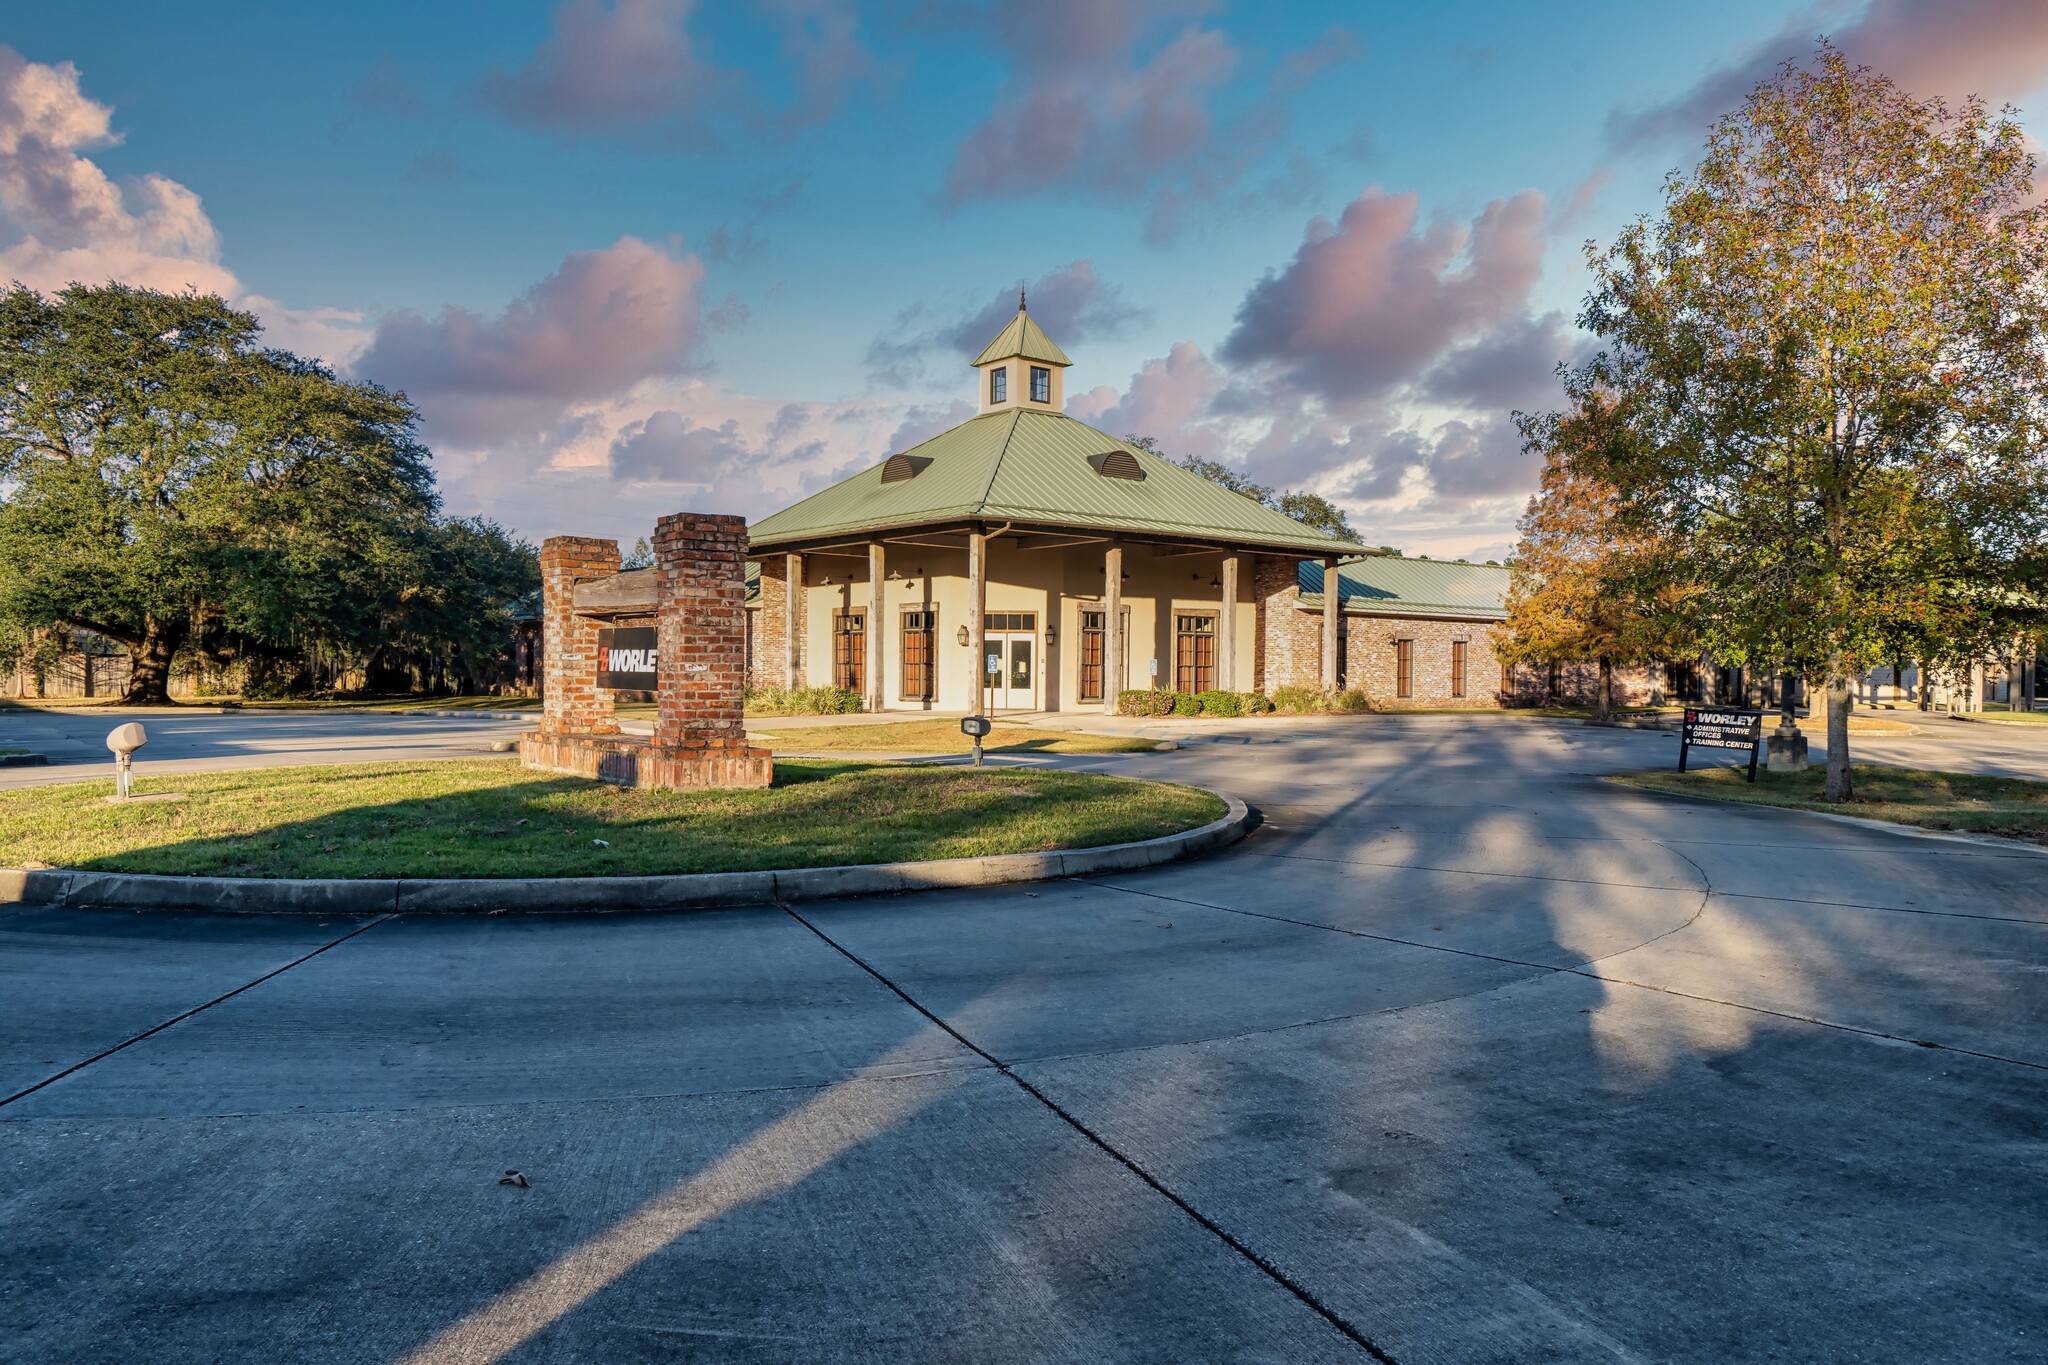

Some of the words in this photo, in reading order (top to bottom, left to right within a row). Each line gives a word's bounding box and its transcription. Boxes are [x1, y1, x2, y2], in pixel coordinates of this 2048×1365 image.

[609, 649, 658, 673] WORLE
[1698, 713, 1757, 725] WORLEY
[1693, 725, 1750, 735] ADMINISTRATIVE
[1692, 738, 1725, 747] TRAINING
[1725, 741, 1754, 749] CENTER
